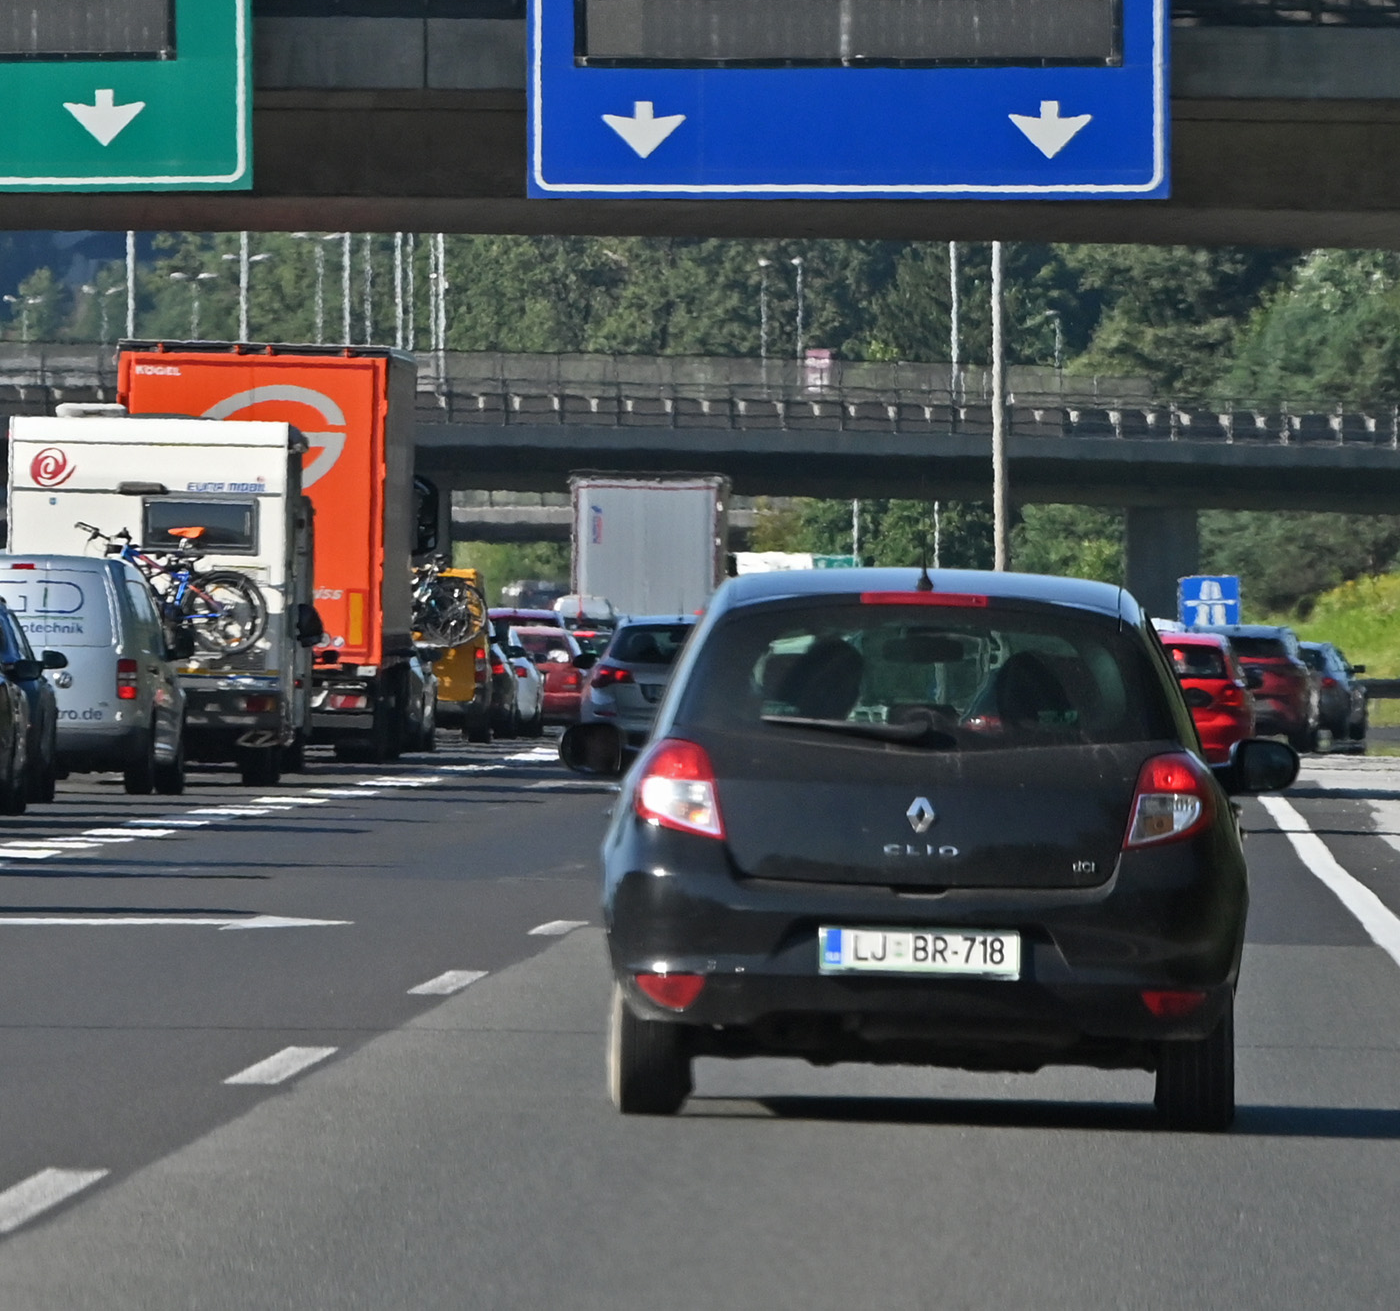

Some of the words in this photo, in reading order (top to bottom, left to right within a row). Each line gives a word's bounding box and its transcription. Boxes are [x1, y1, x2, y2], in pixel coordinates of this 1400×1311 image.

[882, 843, 959, 857] CLIO
[852, 934, 888, 962] LJ
[912, 935, 1006, 965] BR-718
